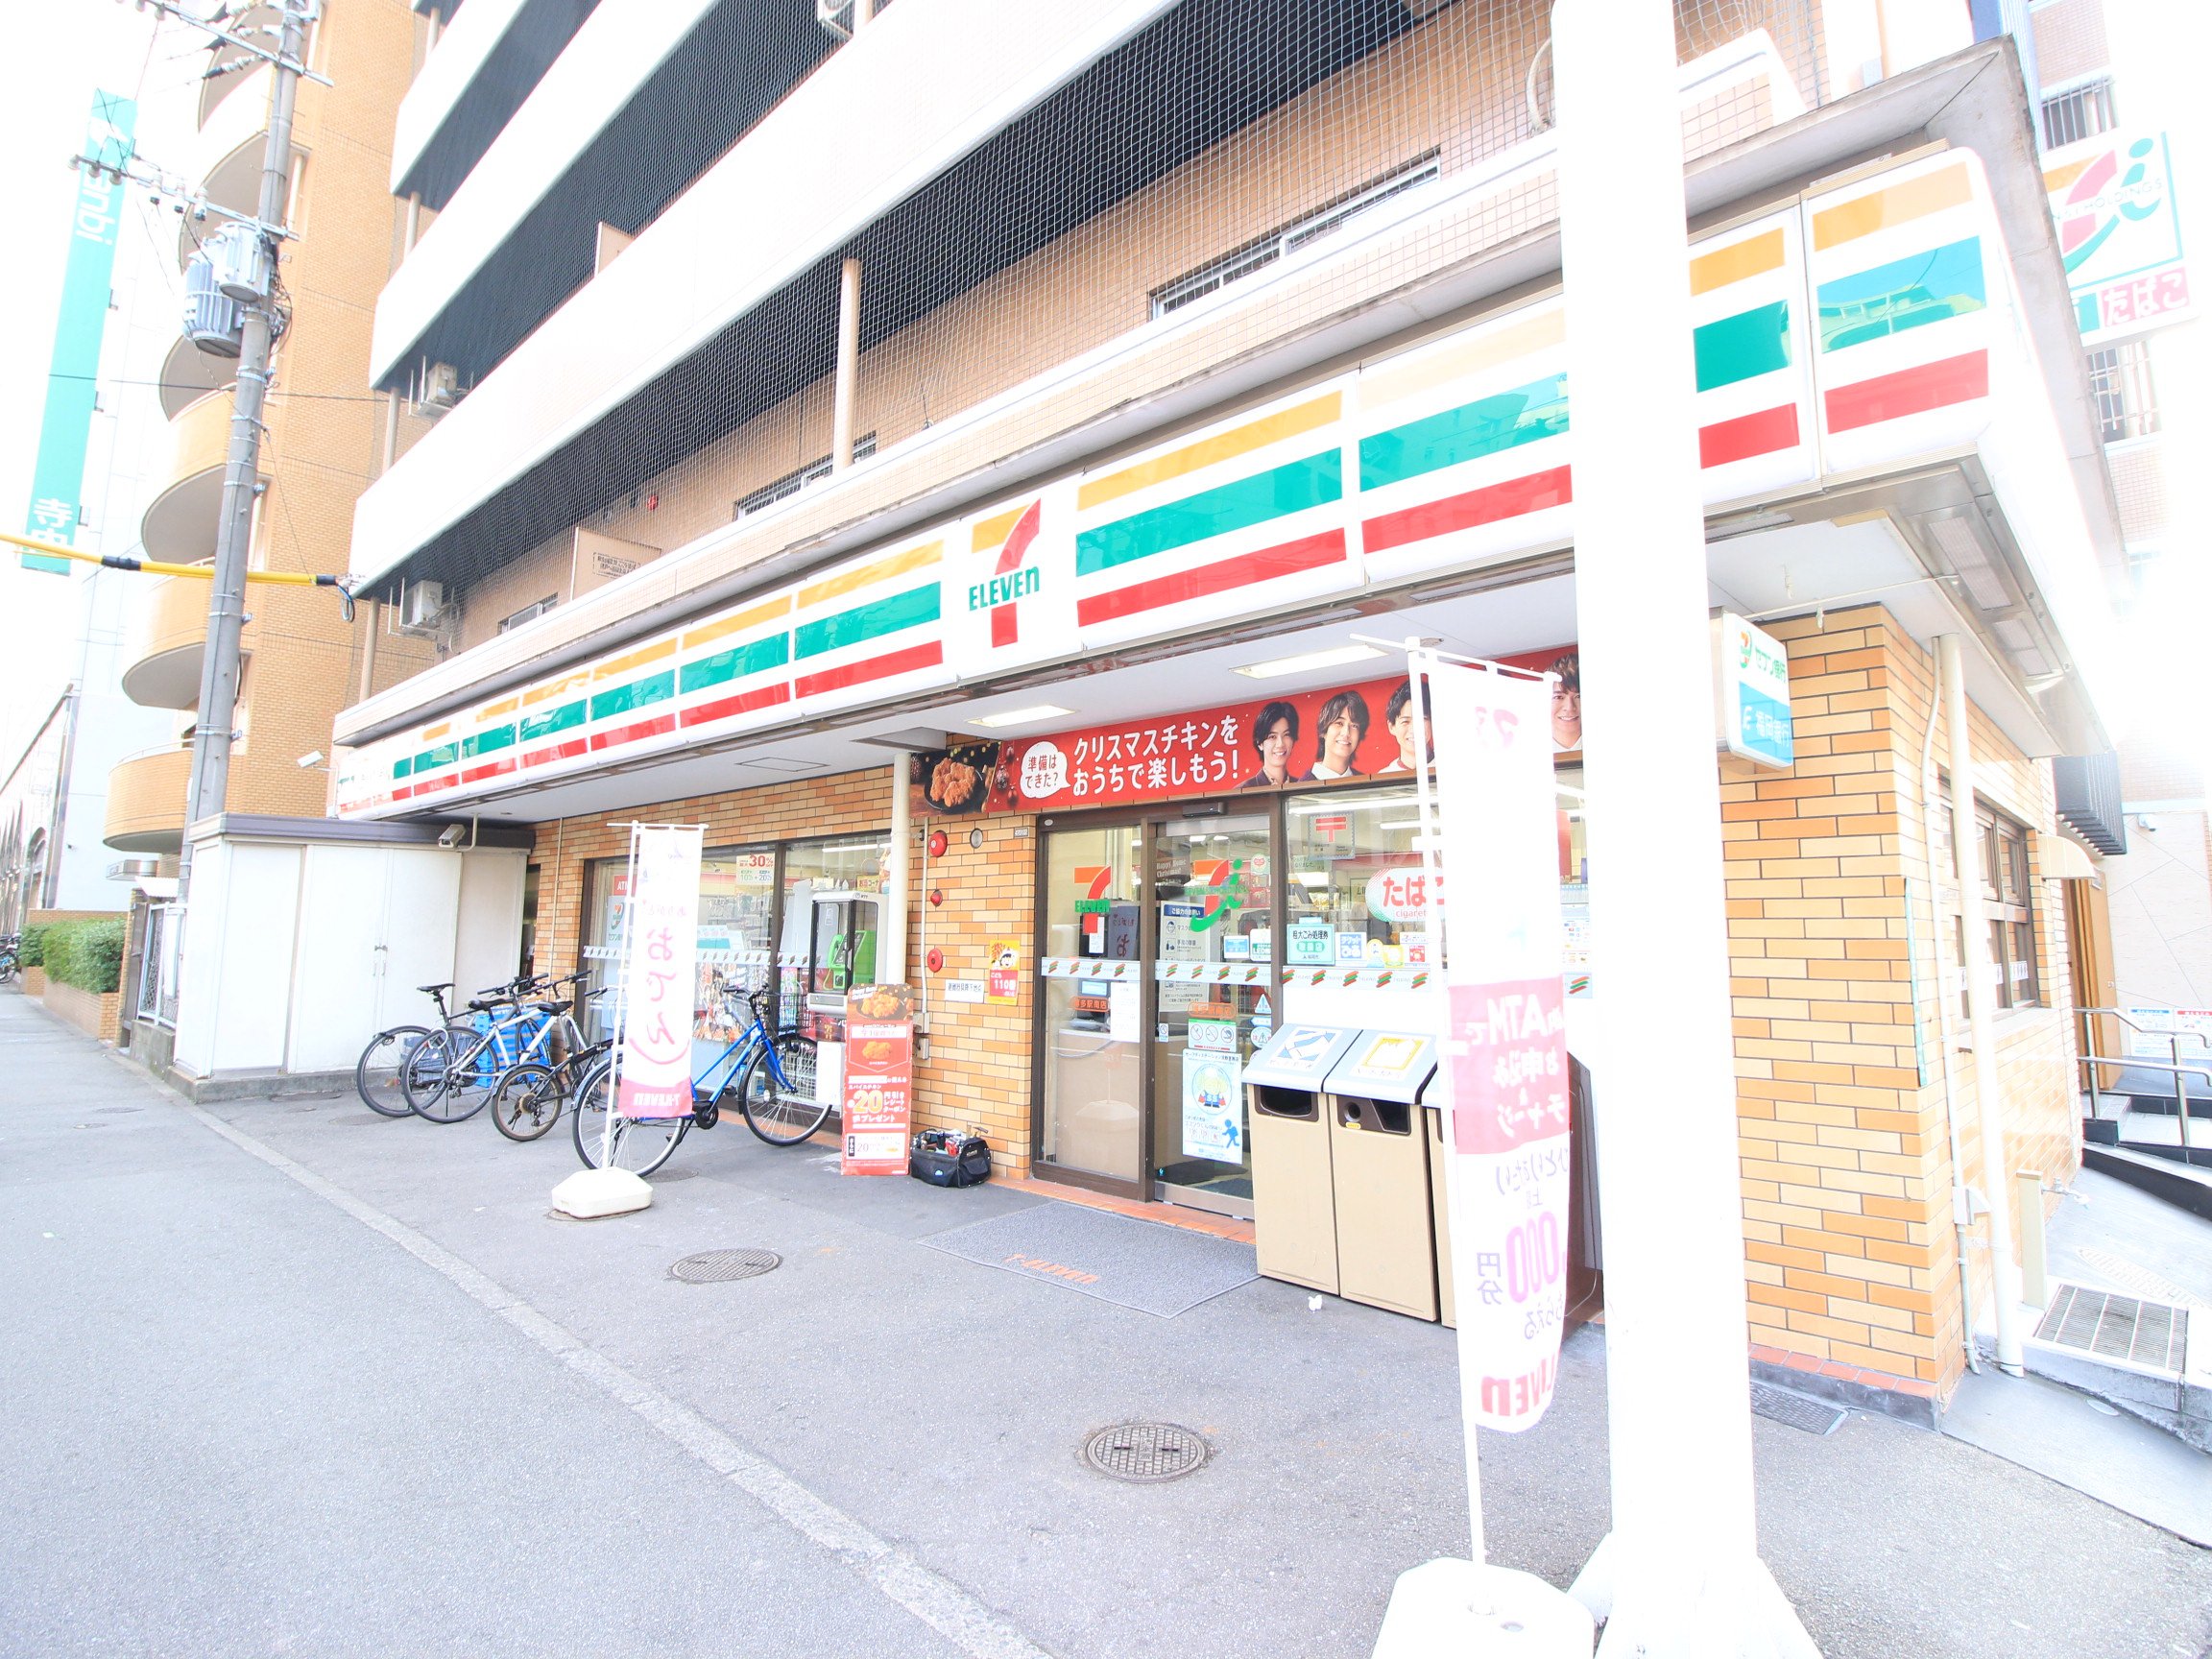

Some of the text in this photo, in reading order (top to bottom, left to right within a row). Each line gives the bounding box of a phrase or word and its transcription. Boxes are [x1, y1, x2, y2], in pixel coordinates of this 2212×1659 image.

[76, 161, 116, 246] anbi
[2104, 273, 2189, 327] たばこ
[1073, 714, 1238, 765] クリスマスチキンを
[1027, 755, 1057, 771] 準備は
[1025, 772, 1058, 789] できた?
[1395, 909, 1427, 918] cigaret
